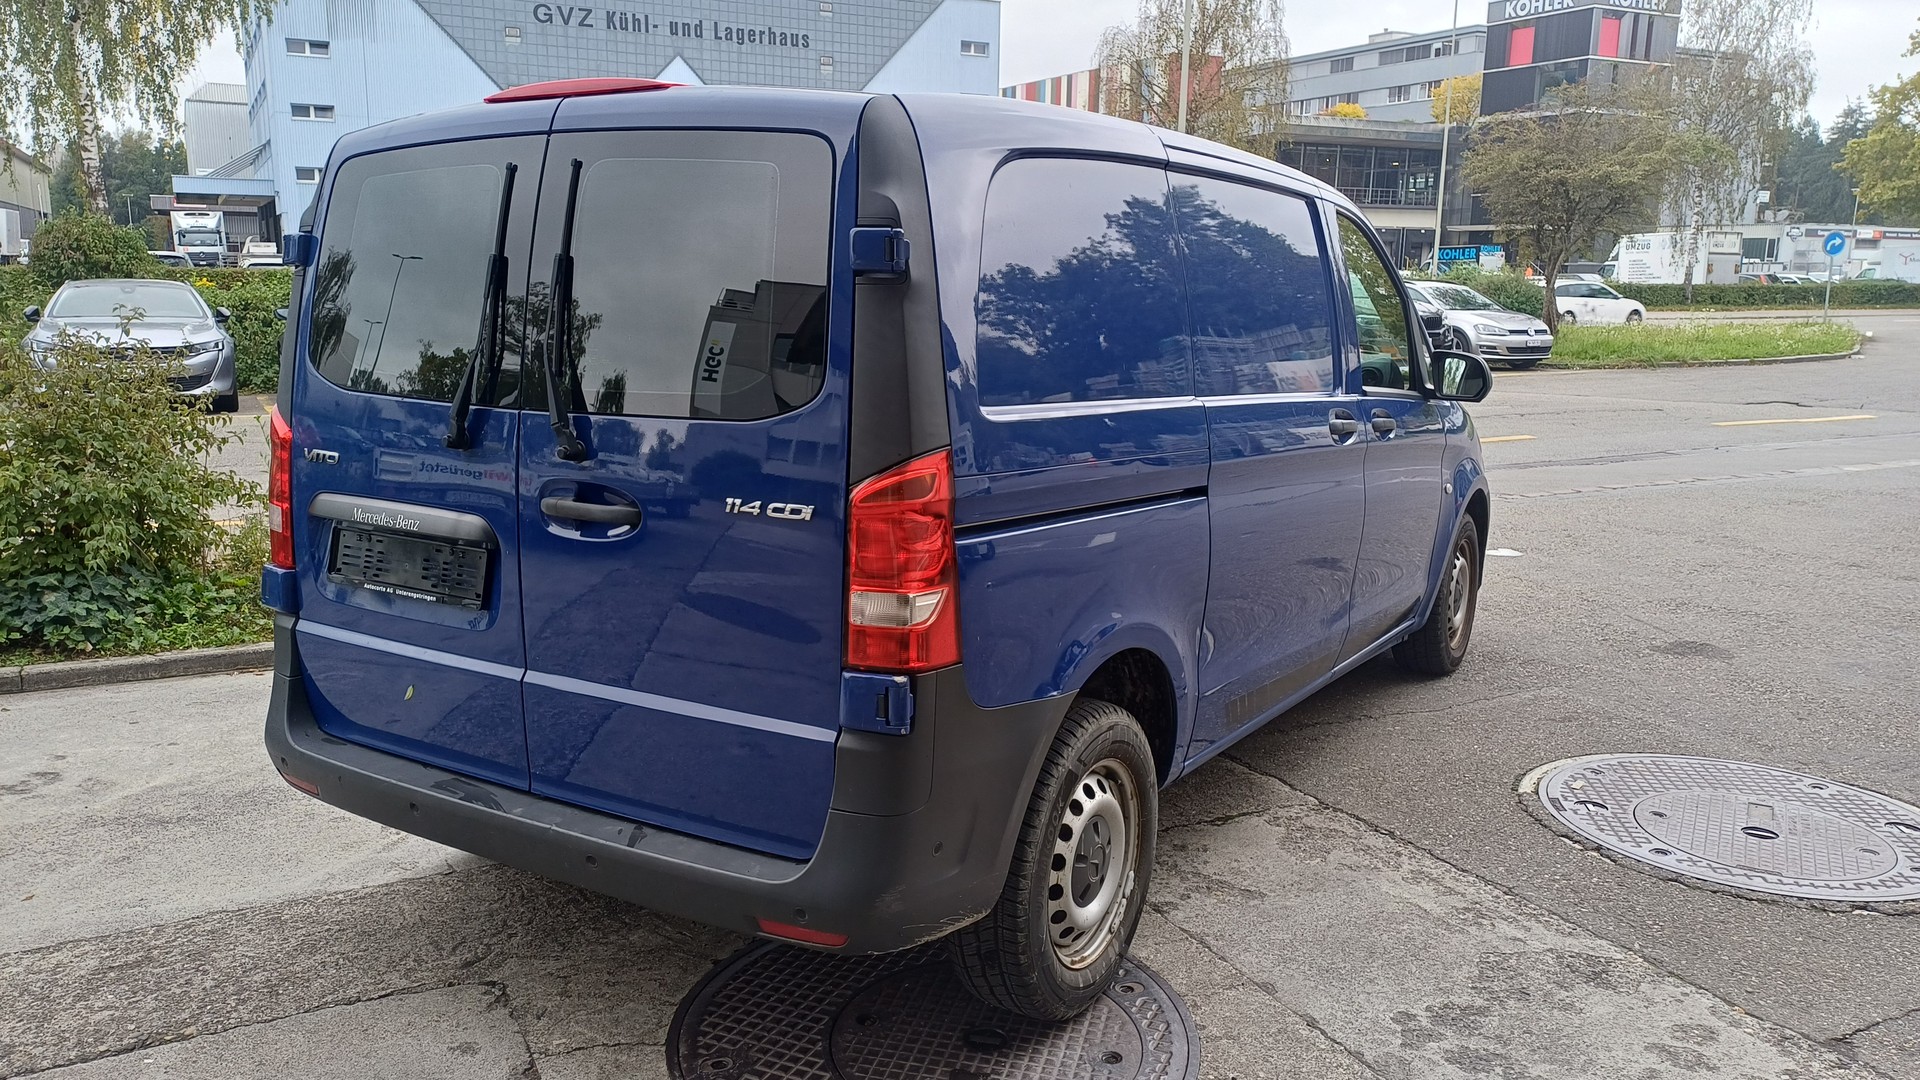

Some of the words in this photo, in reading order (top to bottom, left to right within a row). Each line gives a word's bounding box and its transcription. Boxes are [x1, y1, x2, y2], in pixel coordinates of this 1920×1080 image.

[532, 3, 594, 28] GVZ
[606, 10, 659, 34] Kühl-
[669, 19, 704, 39] und
[713, 21, 811, 49] Lagerhaus
[1437, 247, 1476, 259] KOHLER
[1625, 242, 1651, 251] UMZUG
[303, 447, 340, 465] VITO
[725, 497, 762, 516] 114
[766, 502, 815, 521] CDI
[352, 508, 420, 531] Mercedes-Benz
